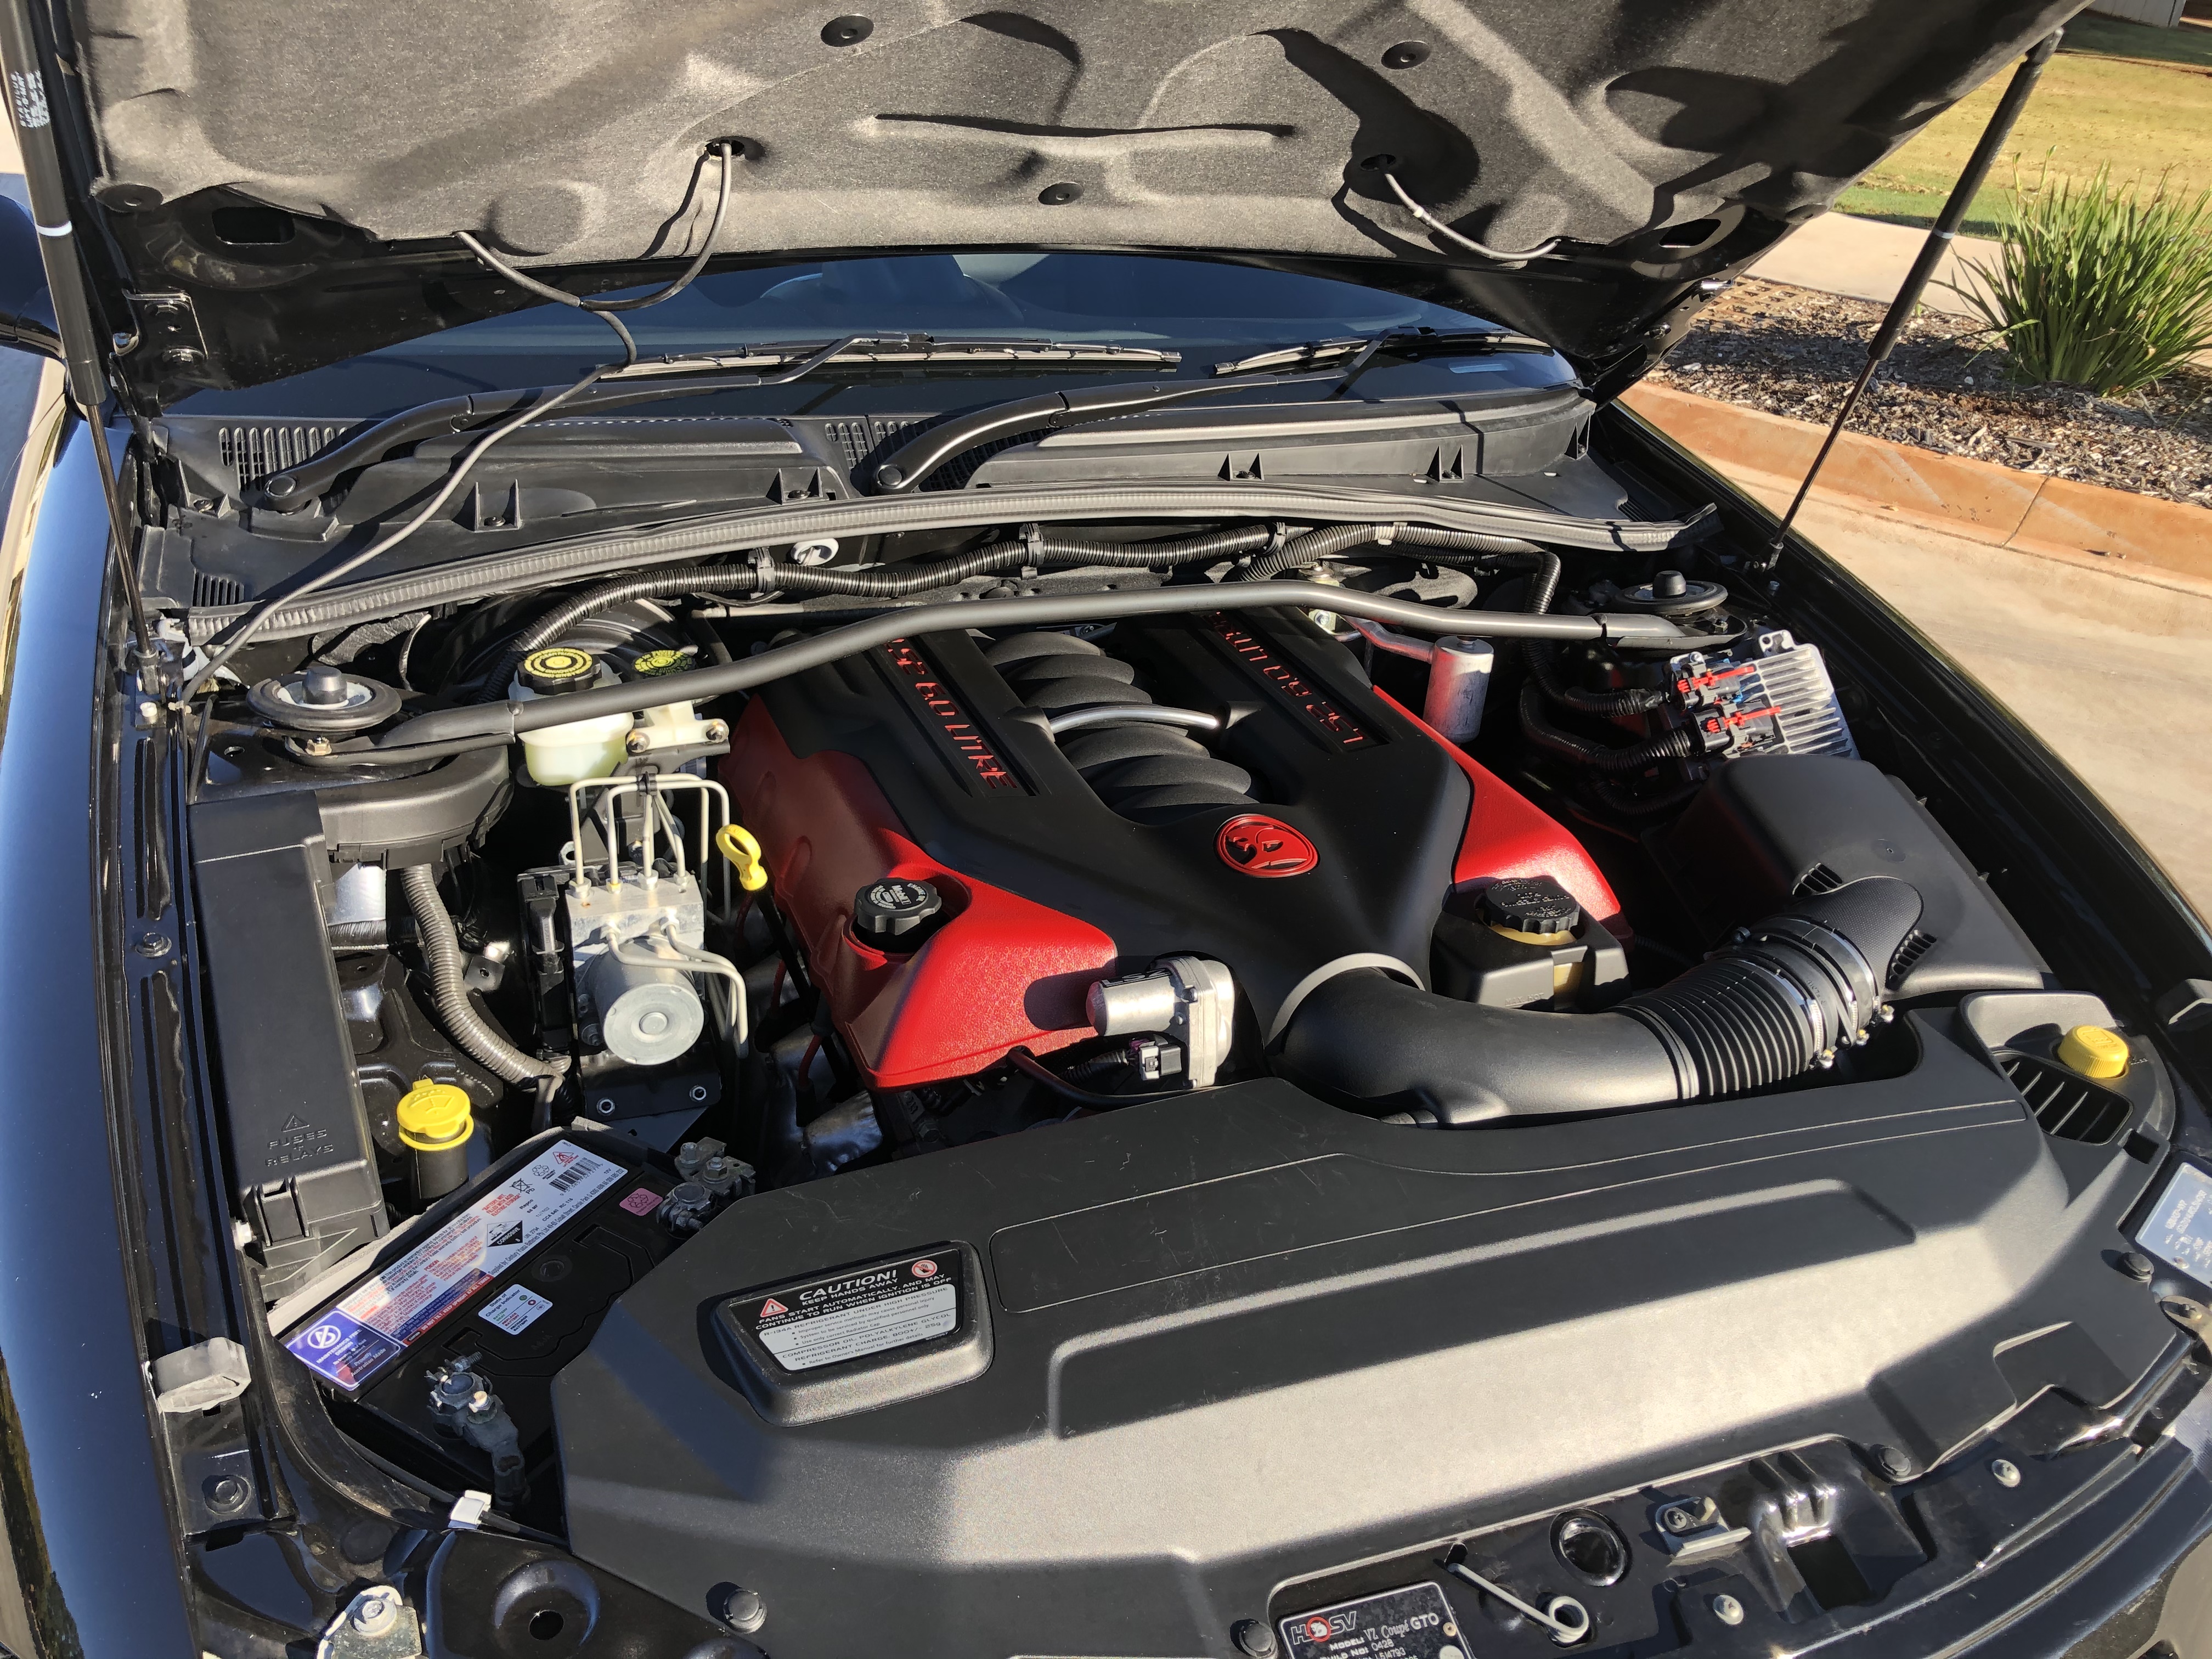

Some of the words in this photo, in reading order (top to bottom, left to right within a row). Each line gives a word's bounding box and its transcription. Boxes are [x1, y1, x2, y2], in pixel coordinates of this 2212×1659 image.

[1263, 665, 1312, 697] 6.0
[915, 682, 960, 716] 6.0
[944, 724, 1017, 789] LITRE
[1306, 702, 1363, 743] LS2
[1102, 969, 1169, 986] LS2
[1505, 996, 1524, 1005] MAX.
[267, 1128, 327, 1150] FUSES
[265, 1144, 334, 1167] RELAYS
[518, 1198, 535, 1210] Repco
[495, 1226, 521, 1245] CORROSIVE
[487, 1262, 505, 1276] Supplied
[504, 1251, 520, 1262] Century
[759, 1313, 785, 1324] FANS
[788, 1305, 819, 1317] START
[902, 1279, 922, 1288] AND
[925, 1273, 945, 1282] MAY
[799, 1269, 897, 1301] CAUTION!
[802, 1295, 827, 1306] KEEP
[831, 1285, 866, 1299] HANDS
[869, 1277, 898, 1289] AWAY
[484, 1304, 503, 1317] Charge
[500, 1289, 522, 1305] Indicator
[489, 1297, 502, 1307] State
[755, 1314, 804, 1330] CONTINUE
[823, 1304, 843, 1313] RUN
[845, 1296, 875, 1307] WHEN
[878, 1285, 918, 1299] IGNITION
[933, 1277, 952, 1285] OFF
[794, 1311, 850, 1329] REFRIGERANT
[853, 1304, 881, 1314] UNDER
[905, 1286, 948, 1301] PRESSURE
[798, 1324, 822, 1334] Improper
[825, 1319, 842, 1328] service
[843, 1313, 867, 1323] methods
[896, 1300, 918, 1309] personal
[800, 1331, 819, 1340] System
[836, 1321, 857, 1331] serviced
[866, 1313, 889, 1323] qualified
[891, 1306, 916, 1317] personnel
[782, 1340, 840, 1358] COMPRESSOR
[859, 1321, 918, 1339] POLYALKYLENE
[921, 1312, 951, 1323] GLYCOL
[826, 1330, 845, 1339] correct
[846, 1324, 868, 1334] Radiator
[855, 1344, 875, 1353] Manual
[885, 1336, 904, 1345] further
[905, 1331, 923, 1340] details
[315, 1337, 351, 1364] MAINTENANCE
[353, 1351, 373, 1367] Proudly
[372, 1347, 387, 1359] Made
[795, 1344, 853, 1362] REFRIGERANT
[1329, 1637, 1365, 1651] MODEL:
[1363, 1628, 1379, 1641] VZ
[1381, 1621, 1410, 1640] Coupé
[1409, 1612, 1440, 1632] GTO
